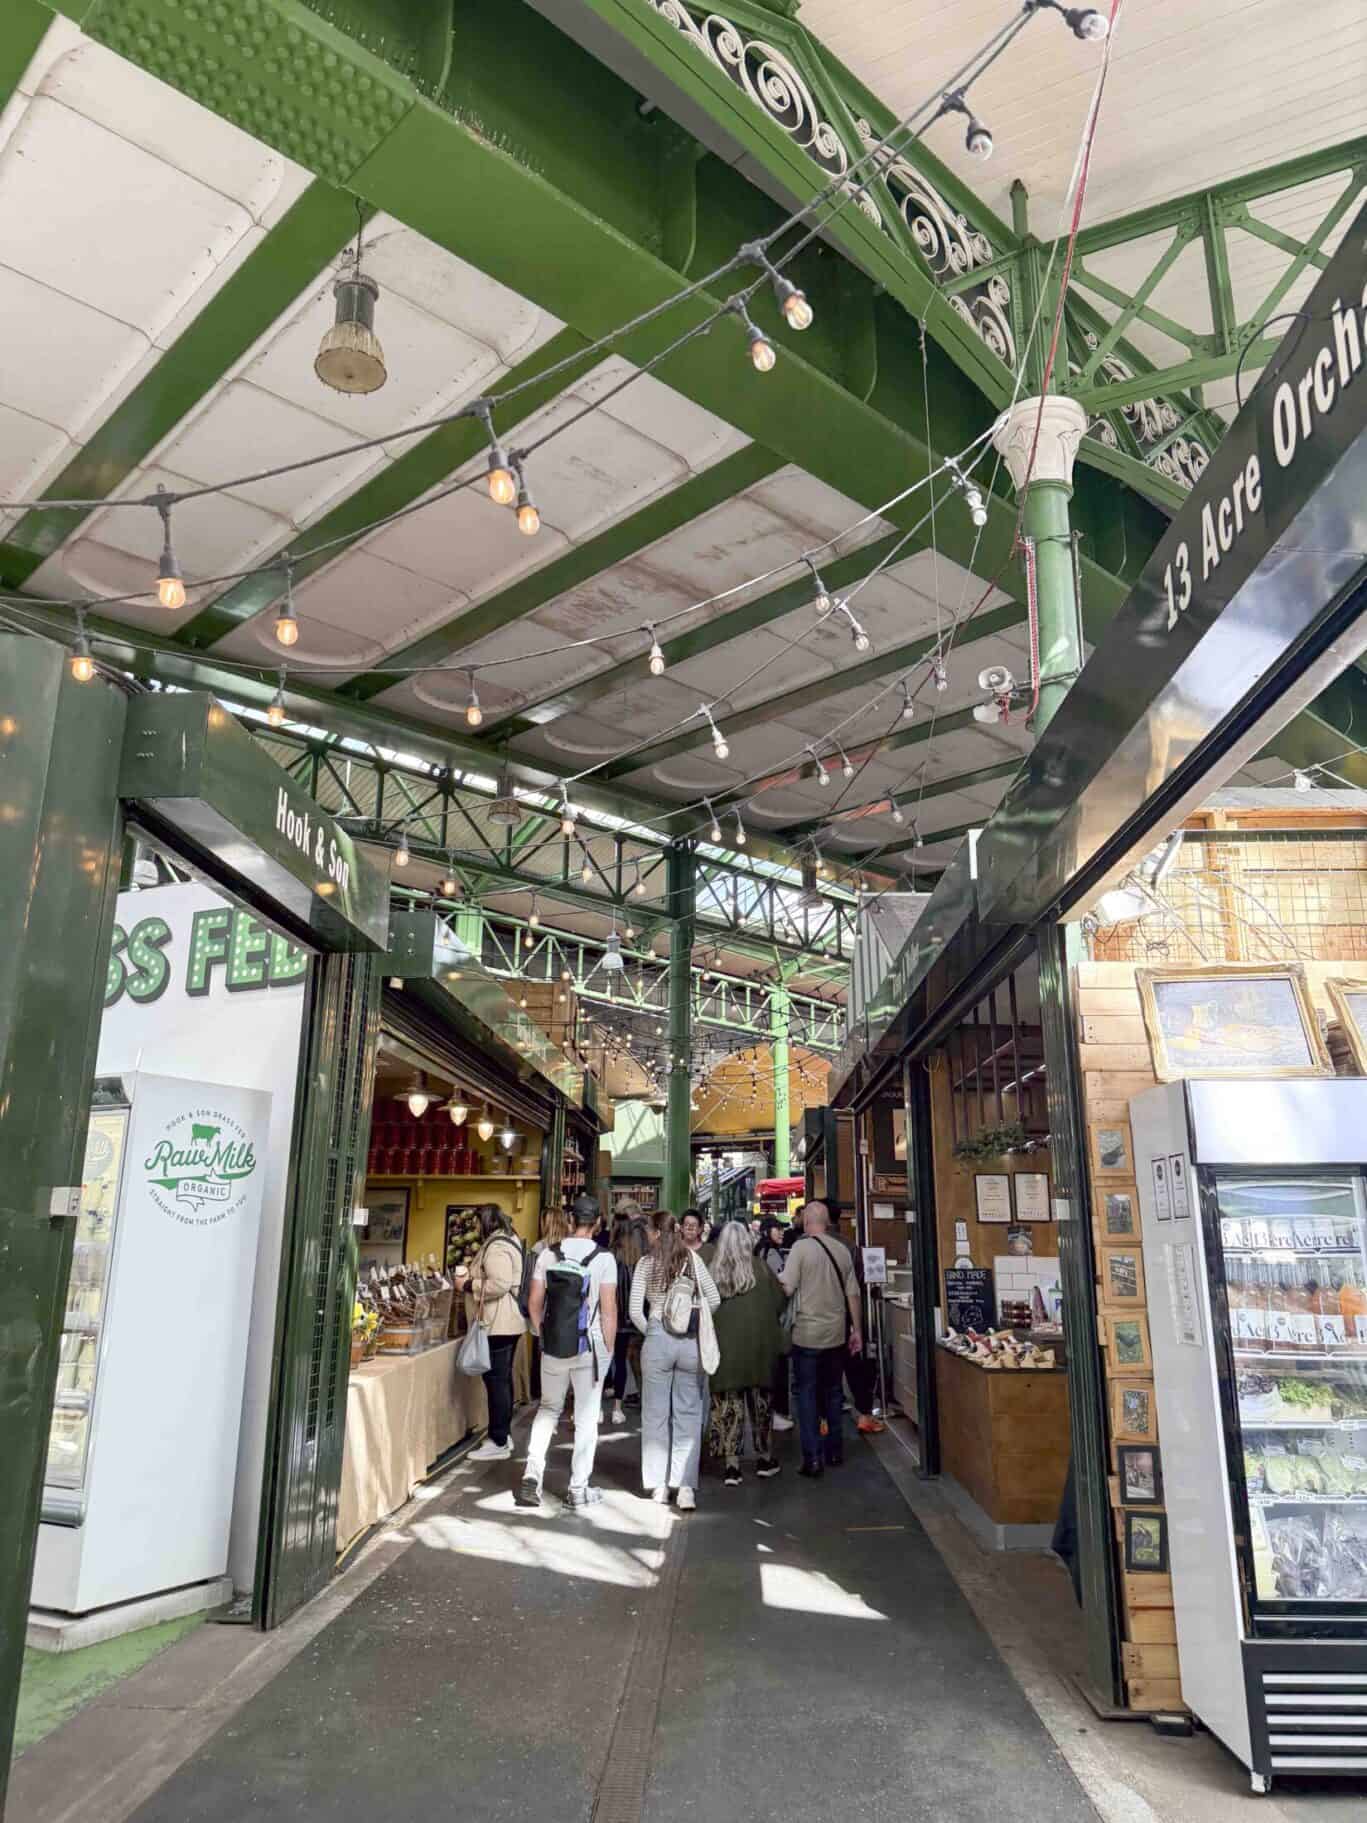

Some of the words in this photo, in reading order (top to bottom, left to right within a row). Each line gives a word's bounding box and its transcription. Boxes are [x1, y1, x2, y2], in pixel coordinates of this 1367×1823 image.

[1164, 542, 1192, 632] 13
[1202, 454, 1263, 581] Acre
[276, 786, 311, 857] Hook
[315, 826, 325, 869] &
[329, 839, 350, 889] Son
[144, 1140, 212, 1177] Raw
[208, 1140, 257, 1173] Milk
[183, 1182, 227, 1196] ORGANIC
